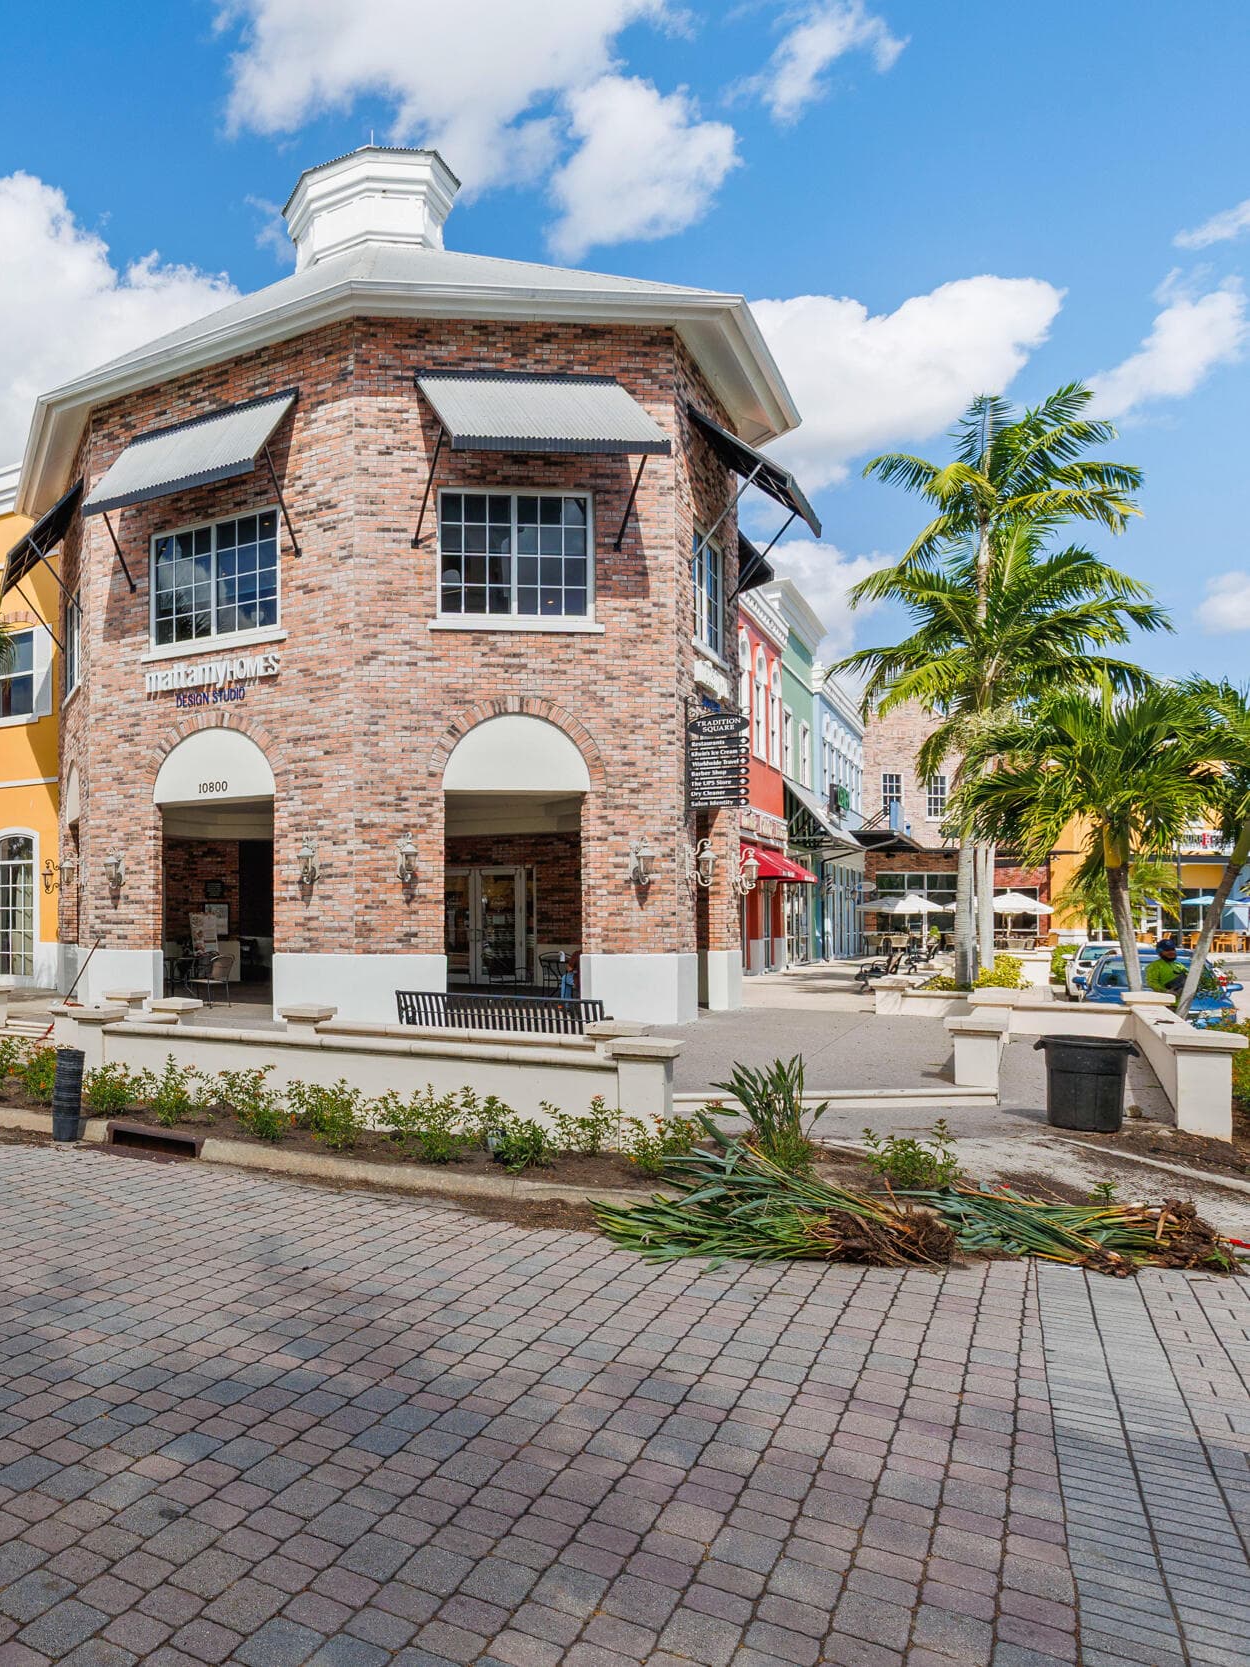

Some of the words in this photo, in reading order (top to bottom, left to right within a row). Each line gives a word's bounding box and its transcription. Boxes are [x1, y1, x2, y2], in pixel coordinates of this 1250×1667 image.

[176, 691, 209, 708] DESIGN
[212, 687, 246, 704] STUDIO
[696, 718, 741, 727] TRADITION
[702, 725, 735, 733] SQUARE
[198, 781, 228, 793] 10800
